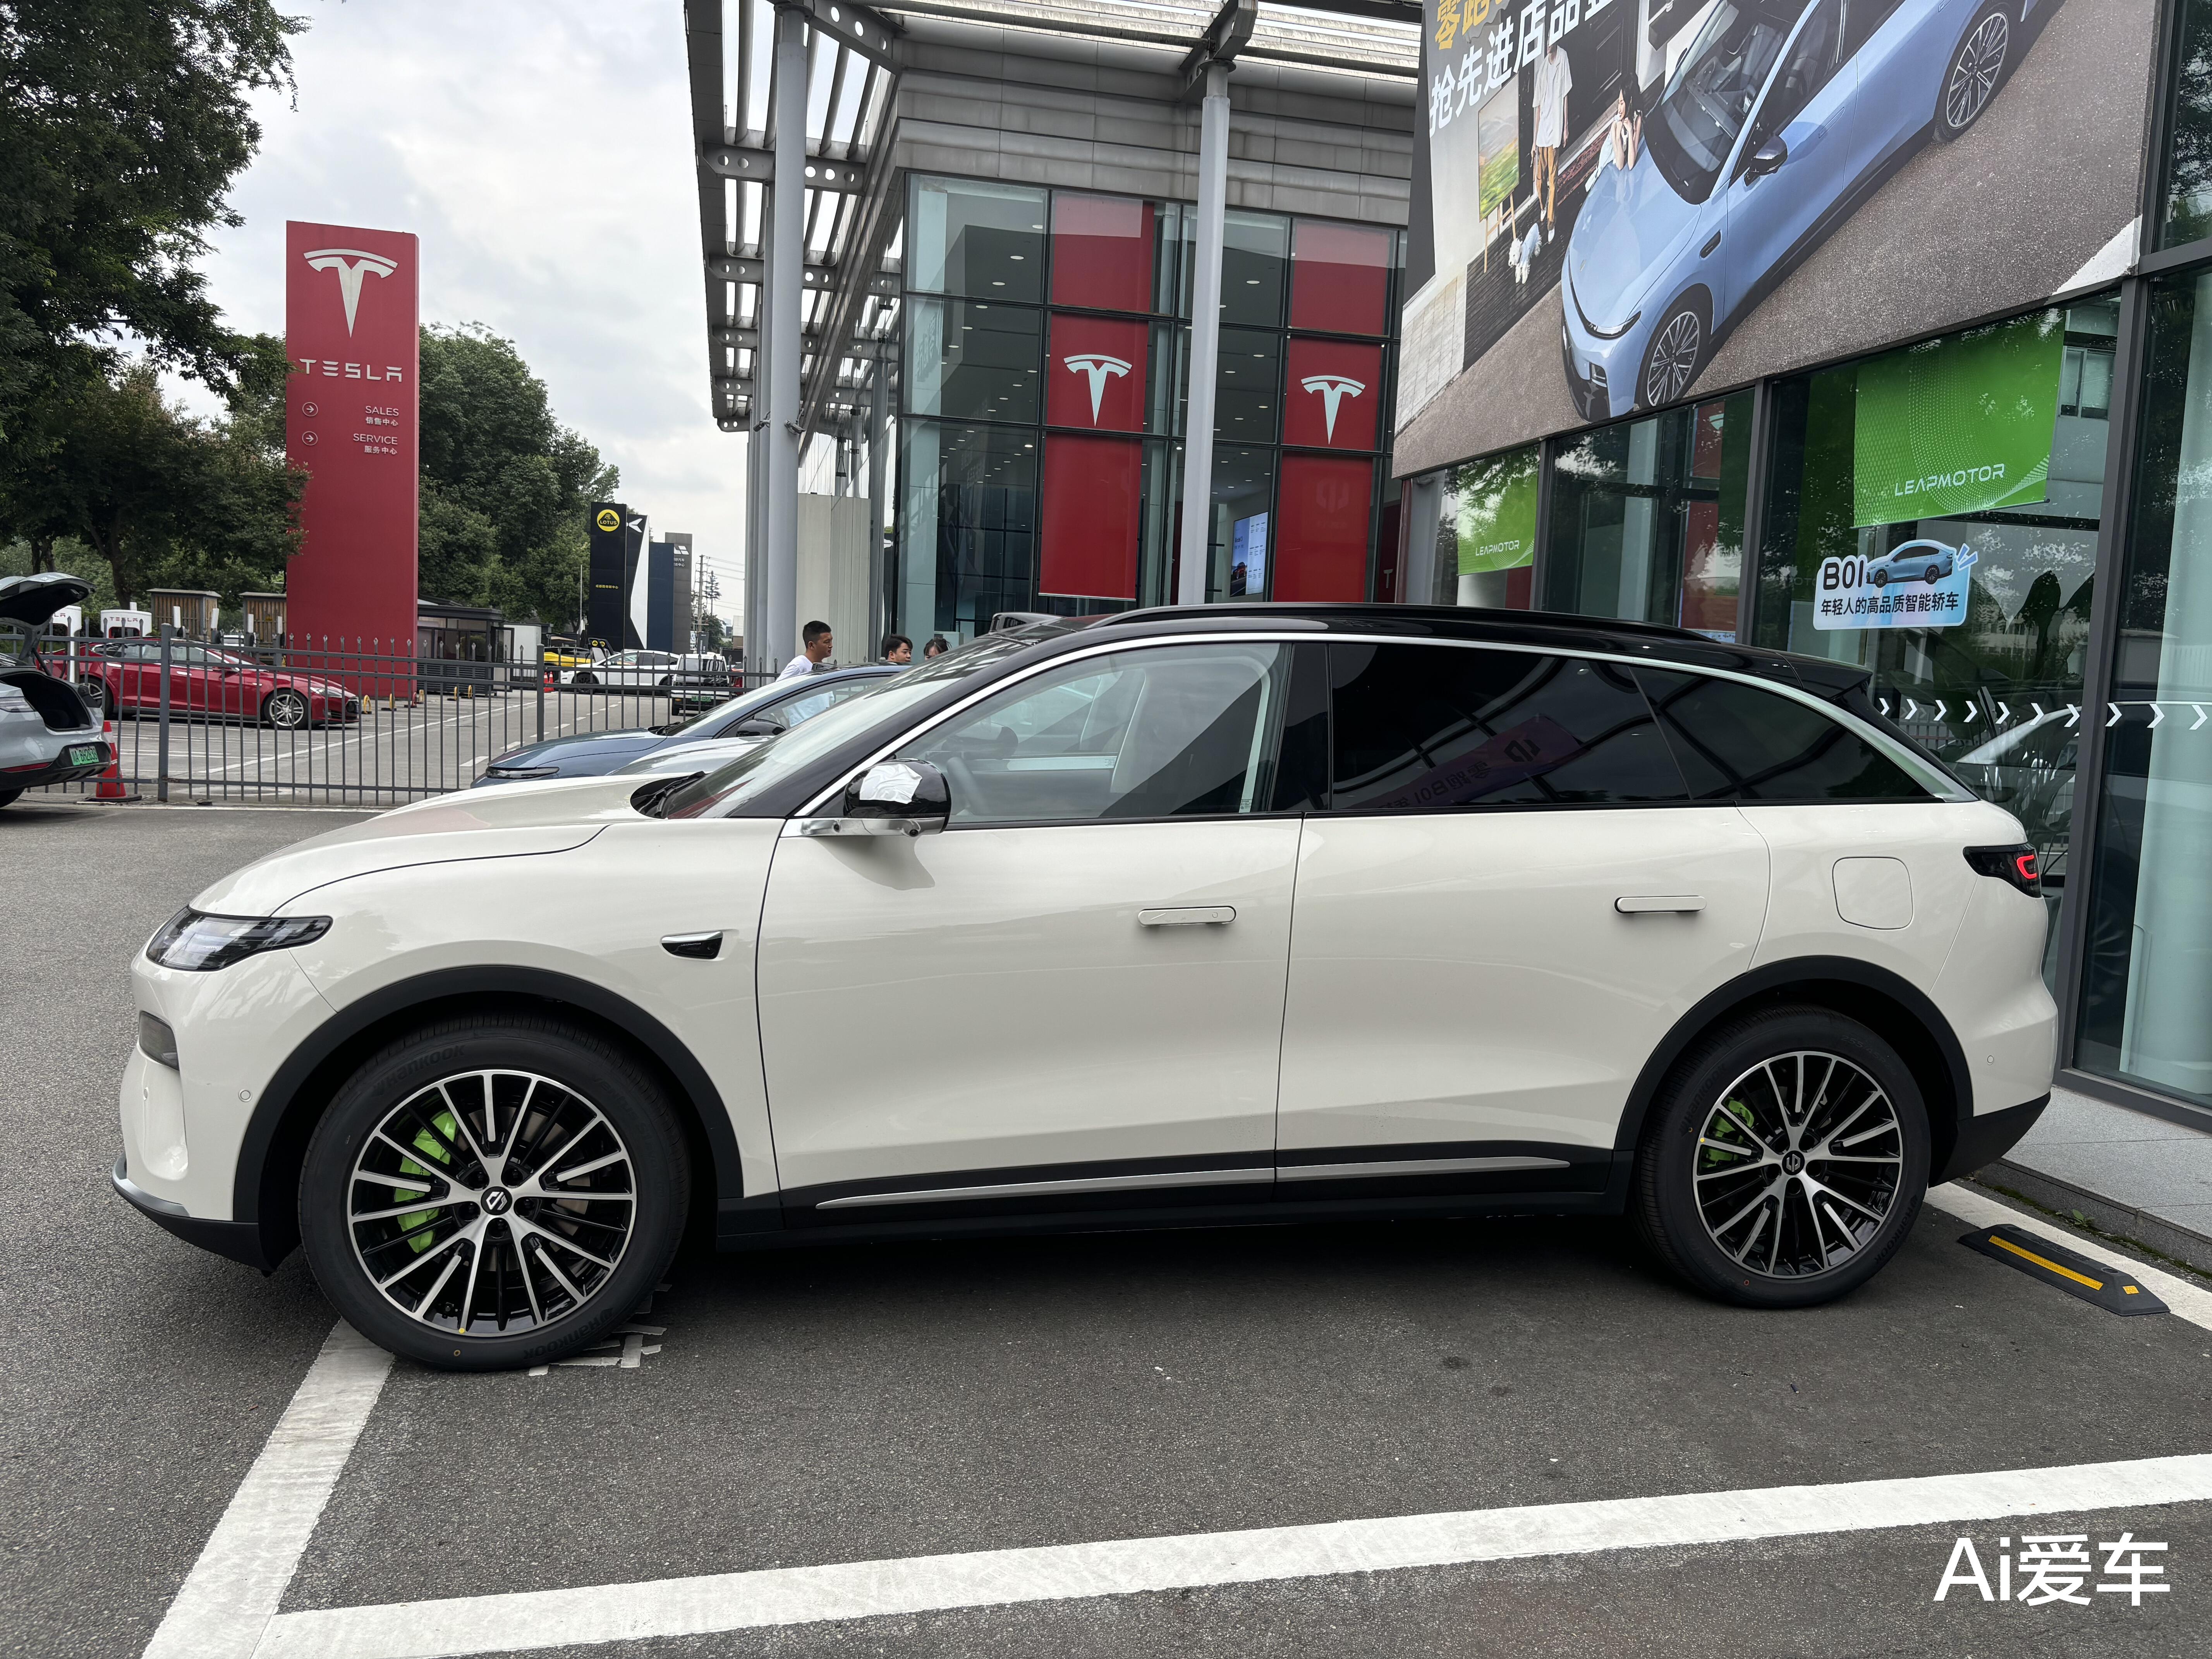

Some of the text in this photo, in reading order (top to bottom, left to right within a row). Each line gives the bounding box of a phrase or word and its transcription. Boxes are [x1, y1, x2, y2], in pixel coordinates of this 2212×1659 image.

[299, 358, 402, 382] TESLA
[365, 405, 399, 416] SALES
[366, 416, 398, 426] 销售中心
[353, 433, 398, 445] SERVICE
[364, 445, 398, 455] 服务中心
[1894, 463, 2005, 496] LEAPMOTOR
[1475, 539, 1520, 556] LEAPMOTOR
[1820, 591, 1959, 617] 年轻人的高品质智能轿车
